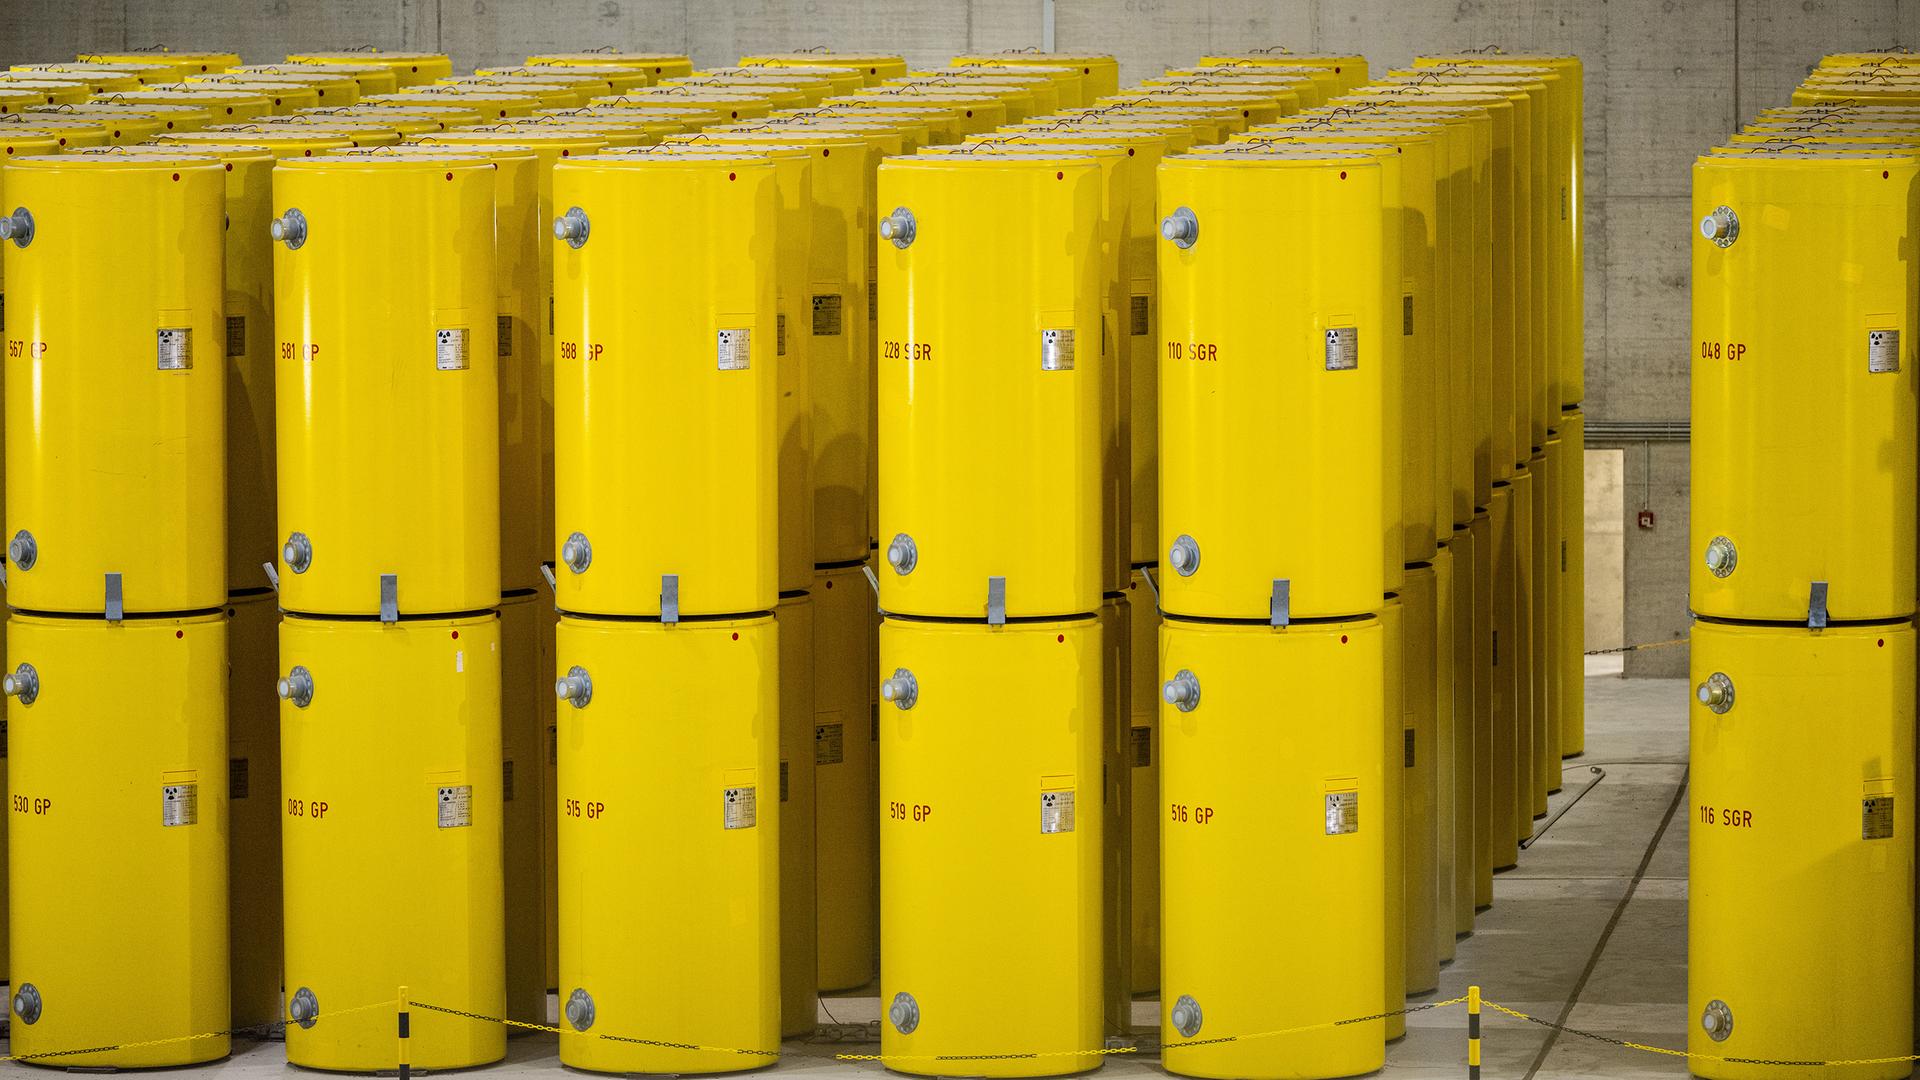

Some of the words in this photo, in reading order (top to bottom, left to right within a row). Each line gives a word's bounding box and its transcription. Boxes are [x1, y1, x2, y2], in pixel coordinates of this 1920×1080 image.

[9, 340, 23, 358] 567
[30, 342, 48, 359] GP
[281, 342, 296, 359] 581
[302, 344, 320, 360] GP
[561, 342, 577, 359] 588
[884, 341, 900, 359] 228
[904, 342, 932, 361] SGR
[1168, 342, 1182, 359] 110
[1189, 343, 1217, 361] SGR
[1702, 341, 1721, 359] 048
[1727, 343, 1747, 361] GP
[13, 795, 29, 813] 530
[34, 798, 51, 815] GP
[288, 798, 304, 816] 083
[311, 801, 328, 819] GP
[566, 799, 581, 817] 515
[587, 802, 604, 819] GP
[890, 802, 906, 820] 519
[913, 804, 931, 822] GP
[1171, 804, 1187, 822] 516
[1195, 807, 1213, 824] GP
[1701, 805, 1715, 824] 116
[1723, 809, 1752, 827] SGR
